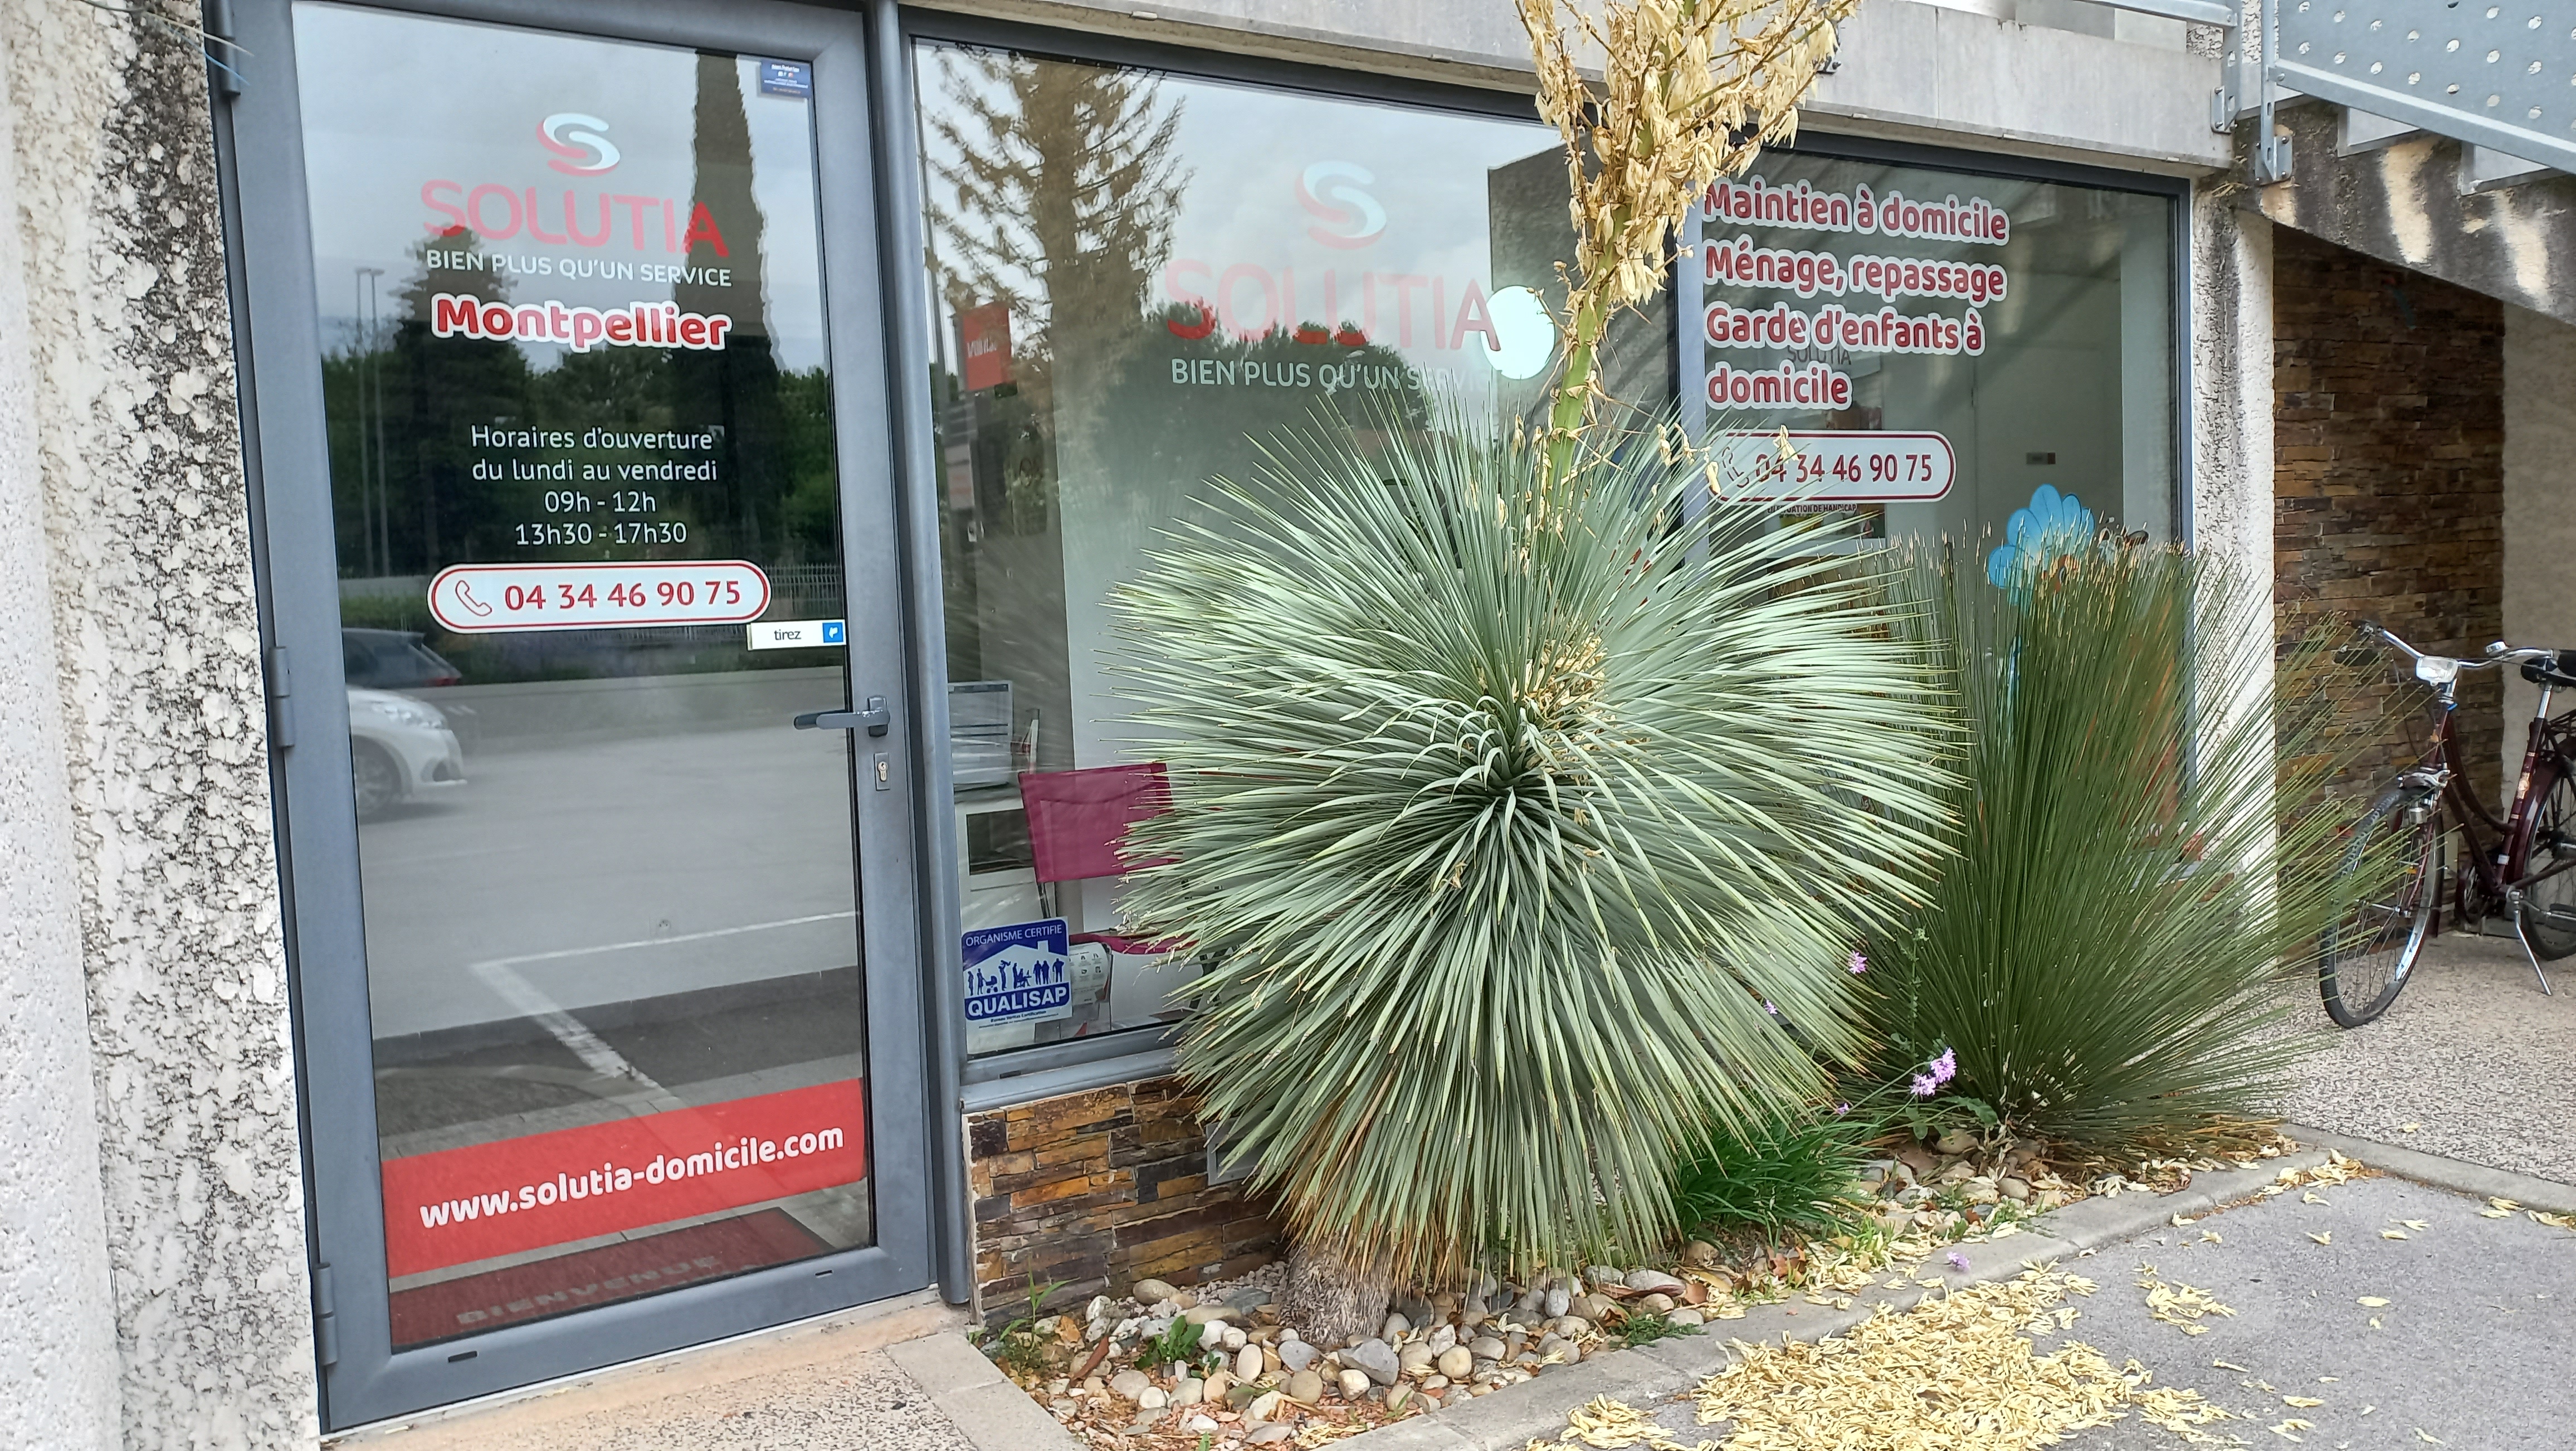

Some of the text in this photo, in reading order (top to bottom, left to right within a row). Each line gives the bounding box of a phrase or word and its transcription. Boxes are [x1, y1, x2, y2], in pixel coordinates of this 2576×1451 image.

[421, 179, 729, 257] SOLUTIA
[1705, 181, 2007, 240] Maintien à domicile
[426, 249, 484, 271] BIEN
[492, 254, 552, 277] PLUS
[640, 263, 732, 288] SERVICE
[1706, 241, 2004, 301] Ménage, repassage
[1163, 259, 1501, 353] SOLUTIA
[437, 298, 728, 347] Montpellier
[1707, 308, 1982, 350] Garde d'enfants à
[1172, 359, 1235, 385] BIEN
[1245, 361, 1311, 388] PLUS
[1709, 369, 1848, 405] domicile
[471, 425, 713, 450] Horaires d'ouverture
[472, 459, 716, 481] du lundi au vendredi
[1756, 454, 1931, 483] 04 34 46 90 75
[545, 490, 590, 513] 09h
[613, 491, 656, 513] 12h
[1813, 504, 1822, 513] DE
[1823, 503, 1857, 512] HANDICAP
[515, 523, 592, 546] 13h30
[614, 522, 687, 544] 17h30
[505, 580, 740, 611] 04 34 46 90 75
[774, 629, 802, 640] tirez
[965, 924, 1062, 947] ORGANISME CERTIFIE
[968, 986, 1067, 1016] QUALISAP
[419, 1126, 843, 1229] www.solutia-domicile.com
